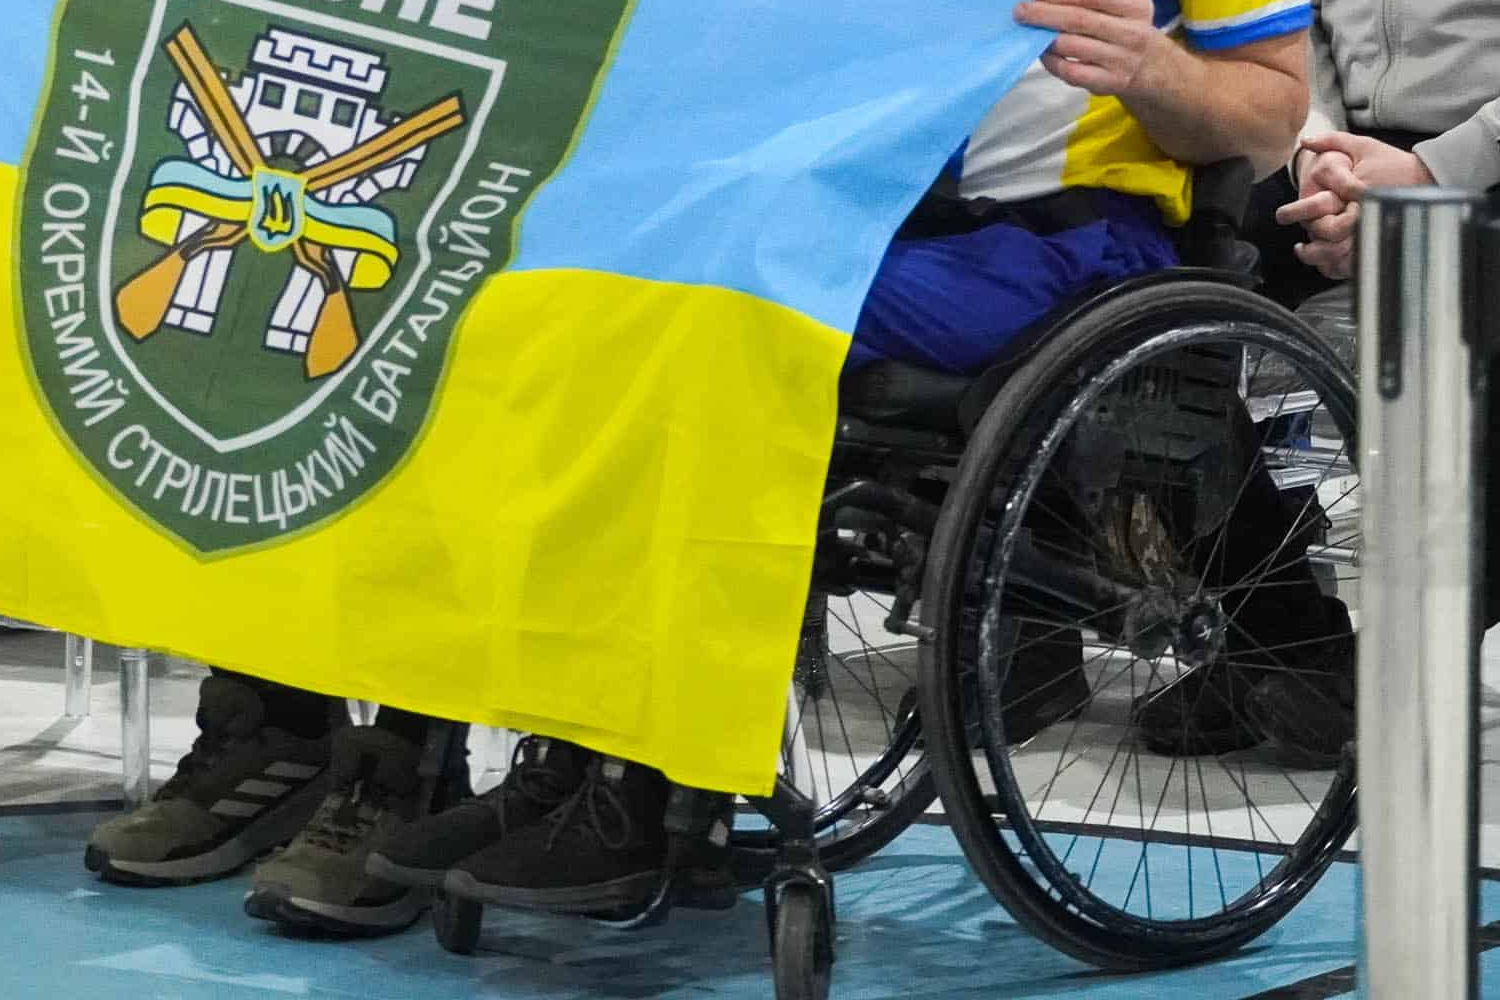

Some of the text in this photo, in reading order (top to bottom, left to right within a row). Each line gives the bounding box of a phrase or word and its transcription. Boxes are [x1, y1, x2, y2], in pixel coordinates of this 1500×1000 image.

[41, 48, 532, 530] 14-Й ОКРЕМИЙ СТРІЛЕЦЬКИЙ БАТАЛЬЙОН
